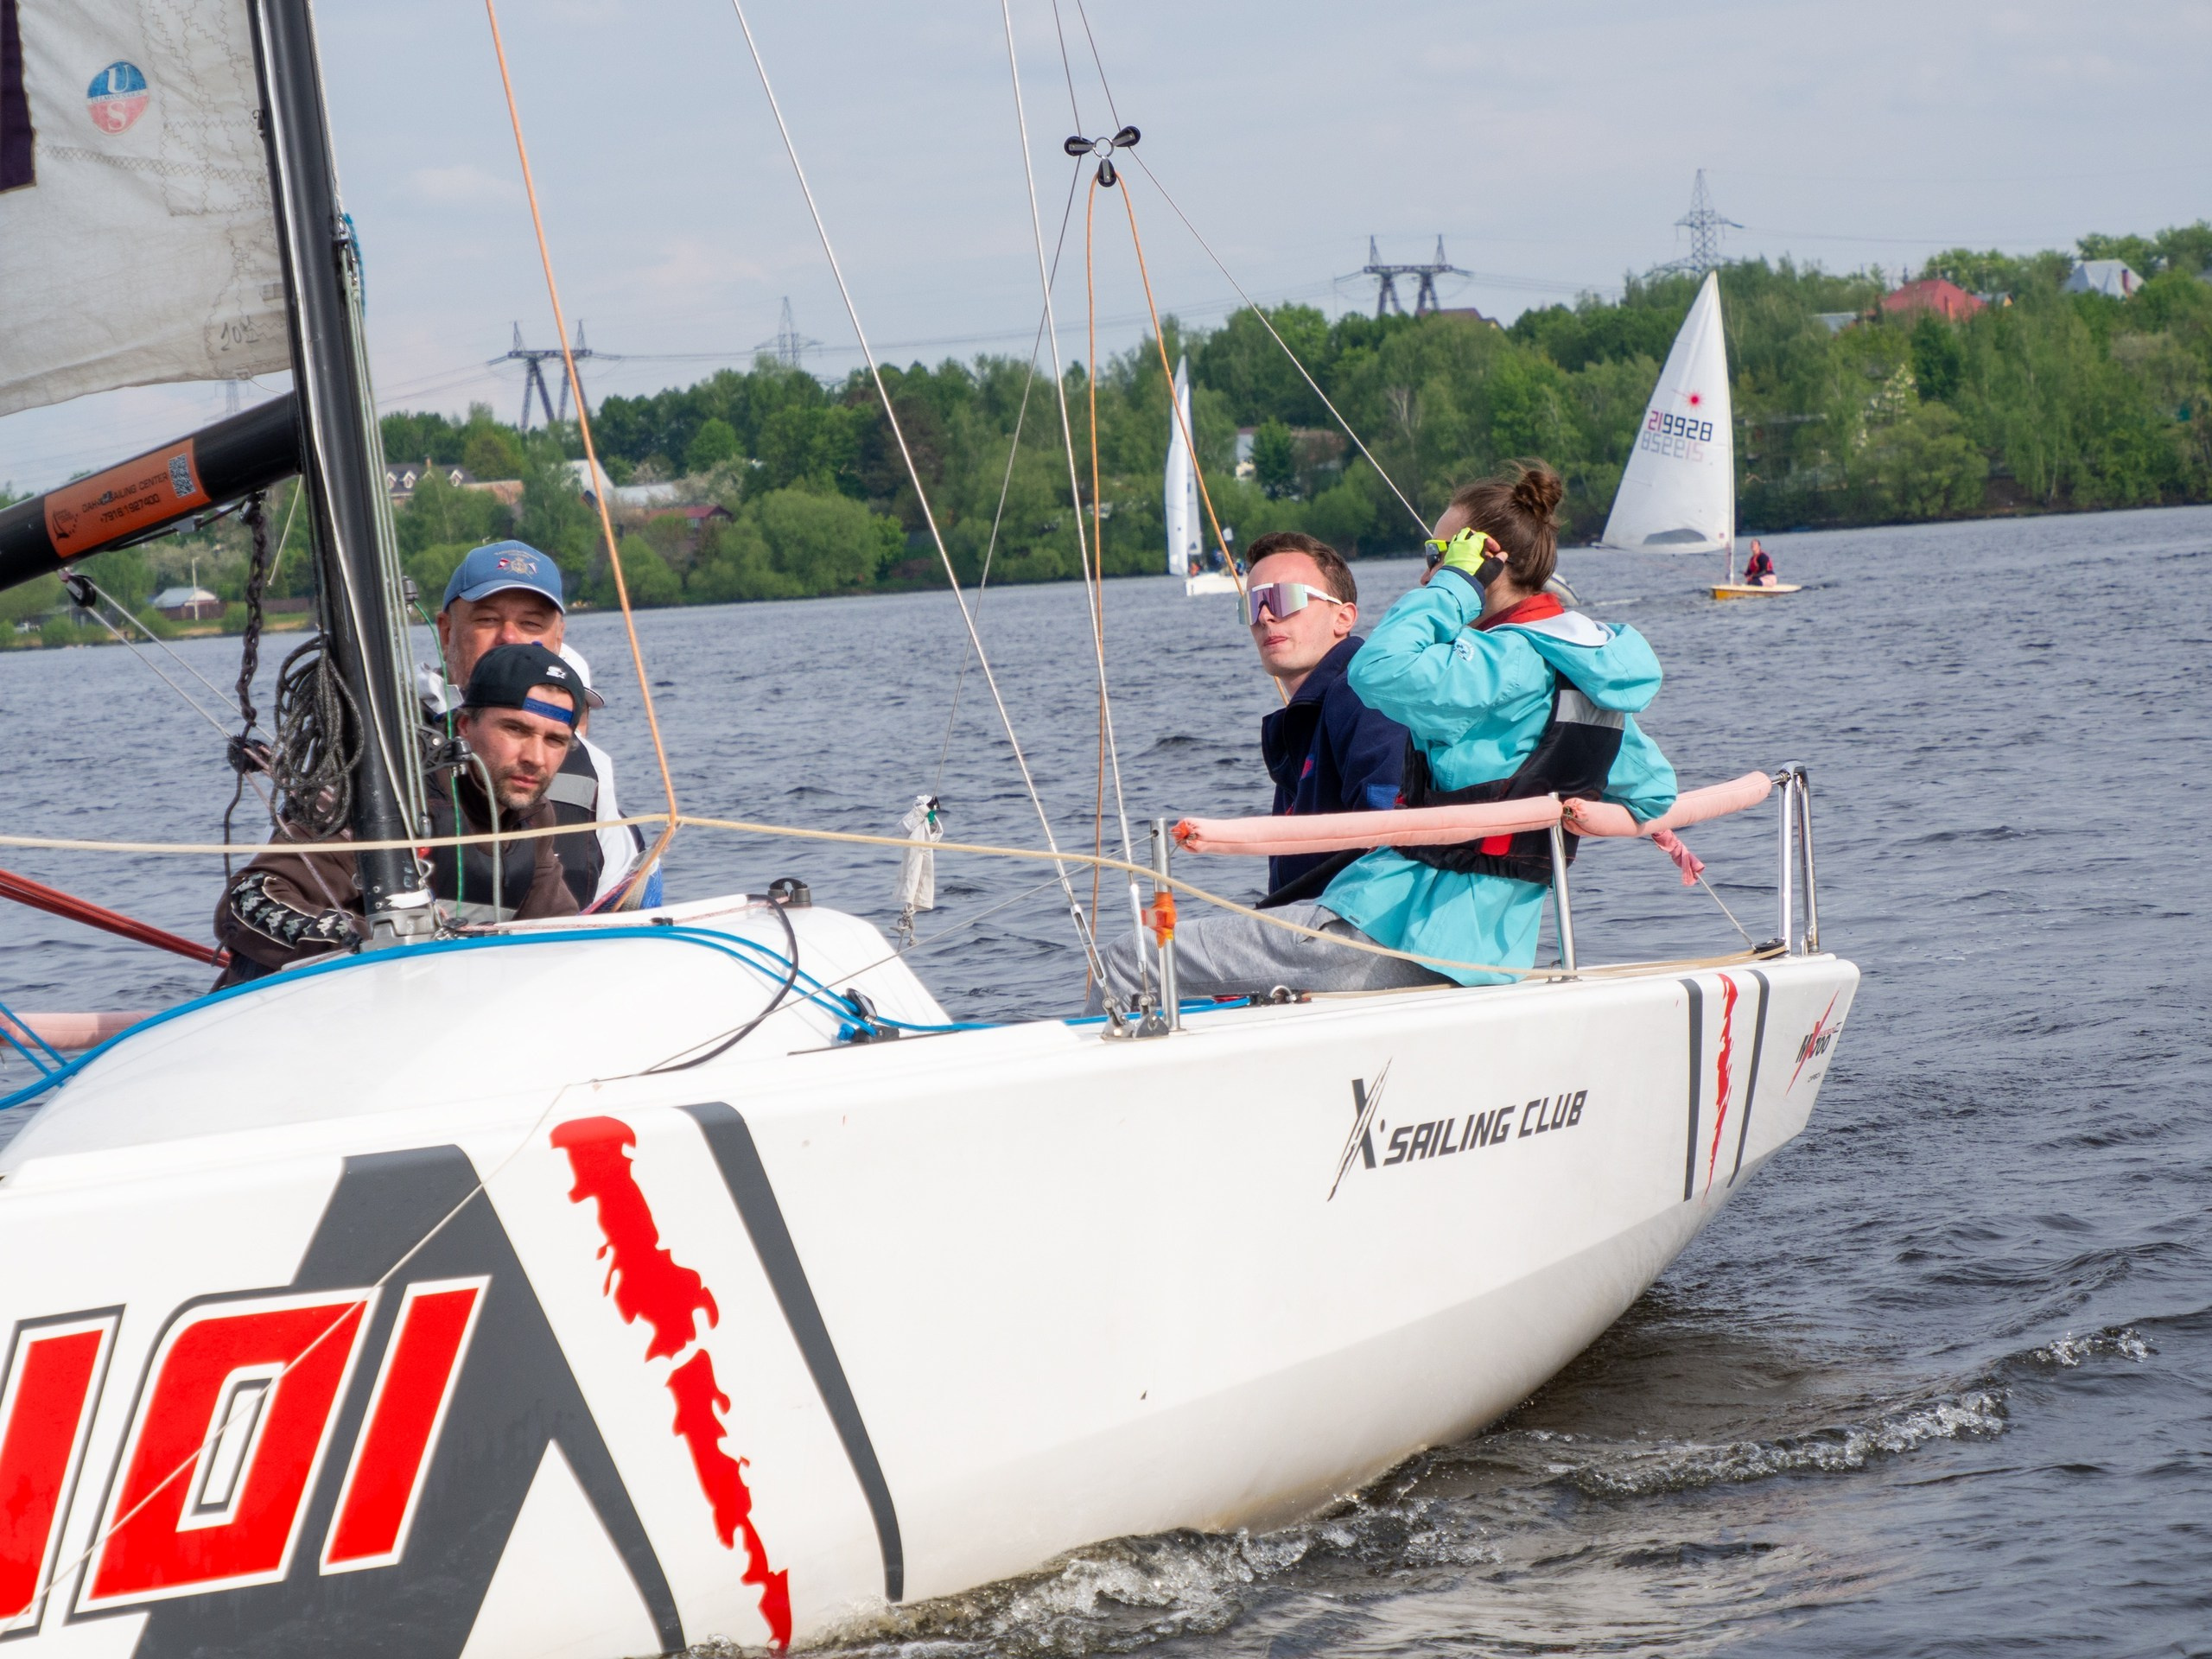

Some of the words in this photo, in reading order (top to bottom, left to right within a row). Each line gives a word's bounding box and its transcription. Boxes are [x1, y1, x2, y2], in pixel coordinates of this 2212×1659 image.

[107, 64, 130, 93] U
[107, 101, 127, 131] S
[1648, 410, 1713, 442] 219928
[138, 471, 168, 491] CENTER
[1382, 1104, 1516, 1166] SAILING
[1517, 1090, 1589, 1140] CLUB
